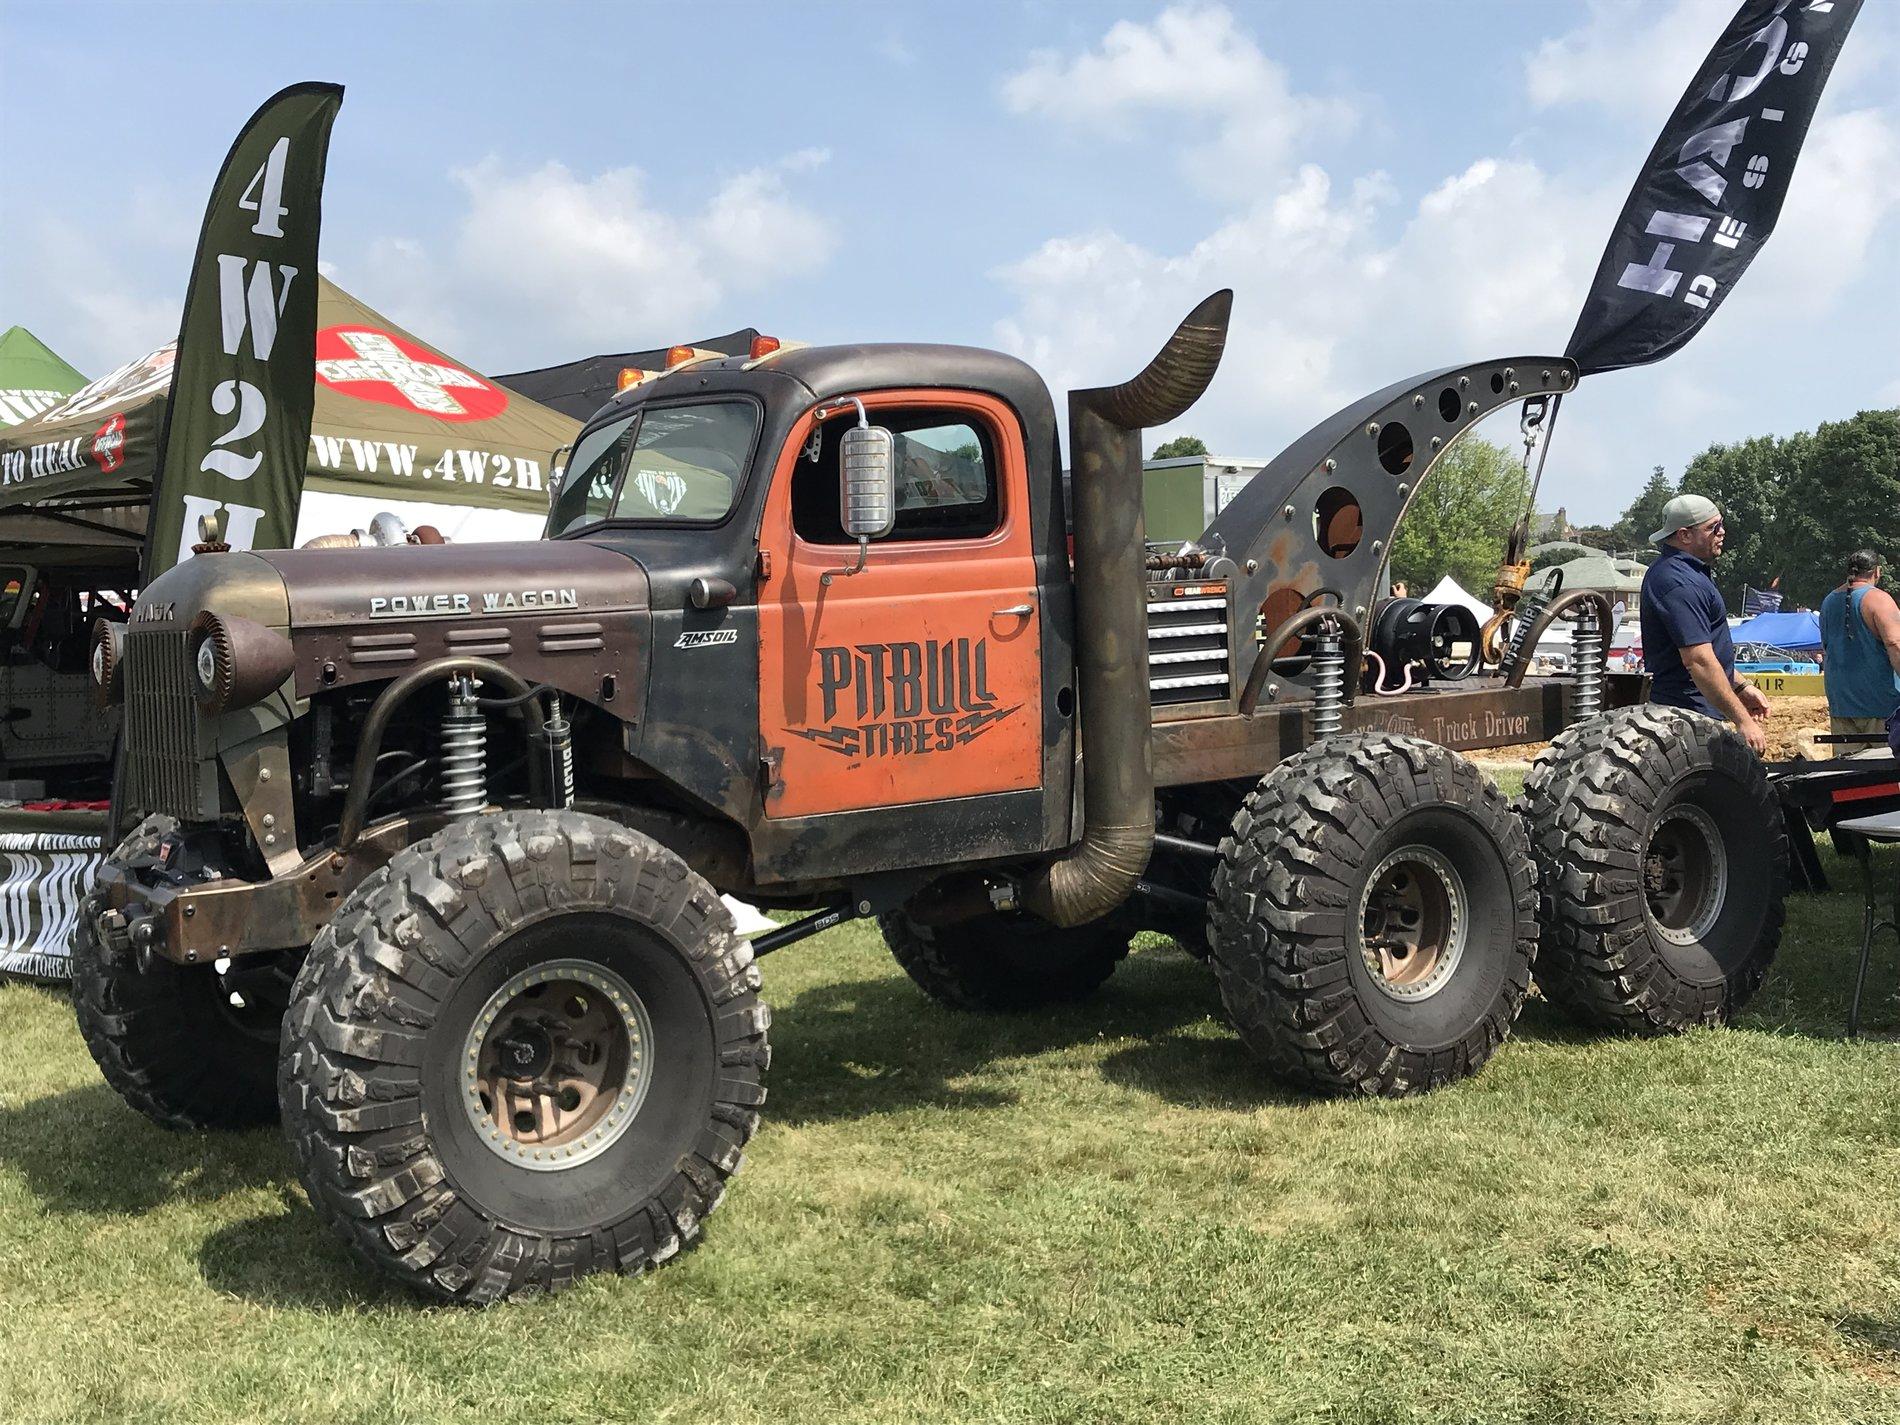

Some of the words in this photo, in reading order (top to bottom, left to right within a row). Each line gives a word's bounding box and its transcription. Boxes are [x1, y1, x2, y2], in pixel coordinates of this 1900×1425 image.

[1617, 0, 1791, 298] HAU
[2, 449, 26, 486] TO
[30, 436, 87, 479] HEAL
[370, 593, 471, 618] POWER
[481, 588, 578, 613] WAGON
[675, 630, 737, 649] AMSOIL
[815, 638, 998, 723] PITBULL
[857, 717, 955, 758] TIRES
[1433, 713, 1478, 745] Truck
[1484, 710, 1530, 738] Driver
